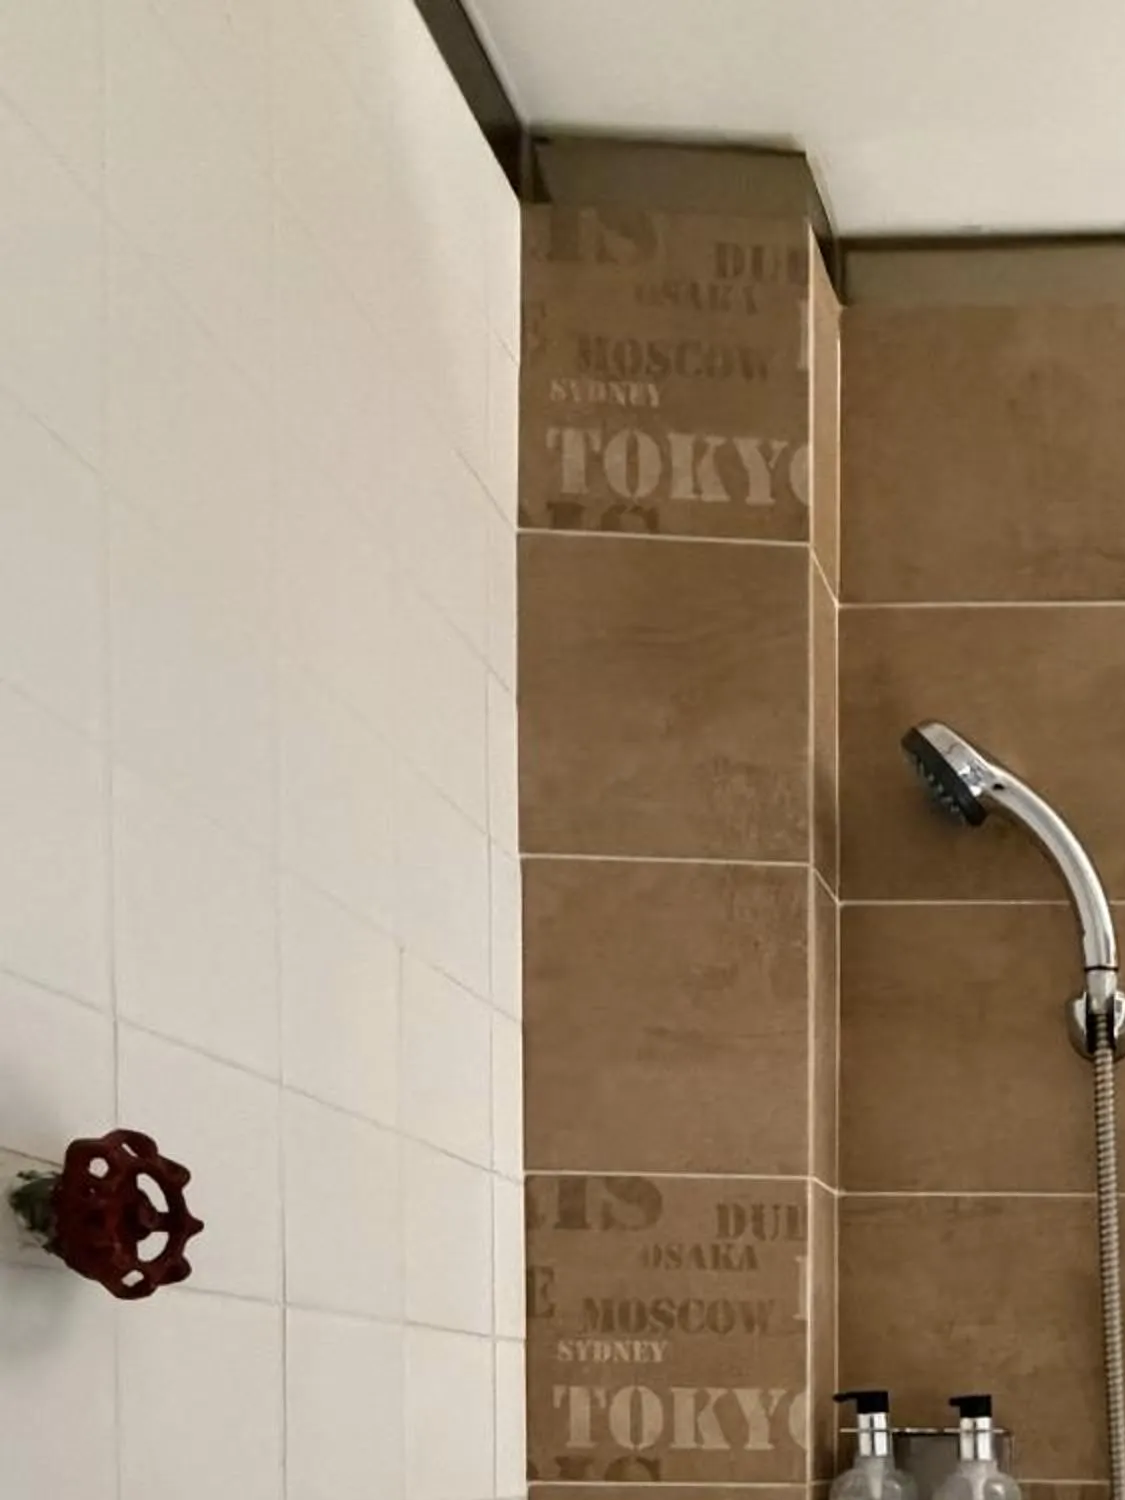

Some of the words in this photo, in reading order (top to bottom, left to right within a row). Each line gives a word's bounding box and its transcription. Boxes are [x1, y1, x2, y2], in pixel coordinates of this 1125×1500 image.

[641, 1243, 760, 1271] OSAKA
[581, 1297, 775, 1335] MOSCOW
[557, 1339, 668, 1364] SYDNEY
